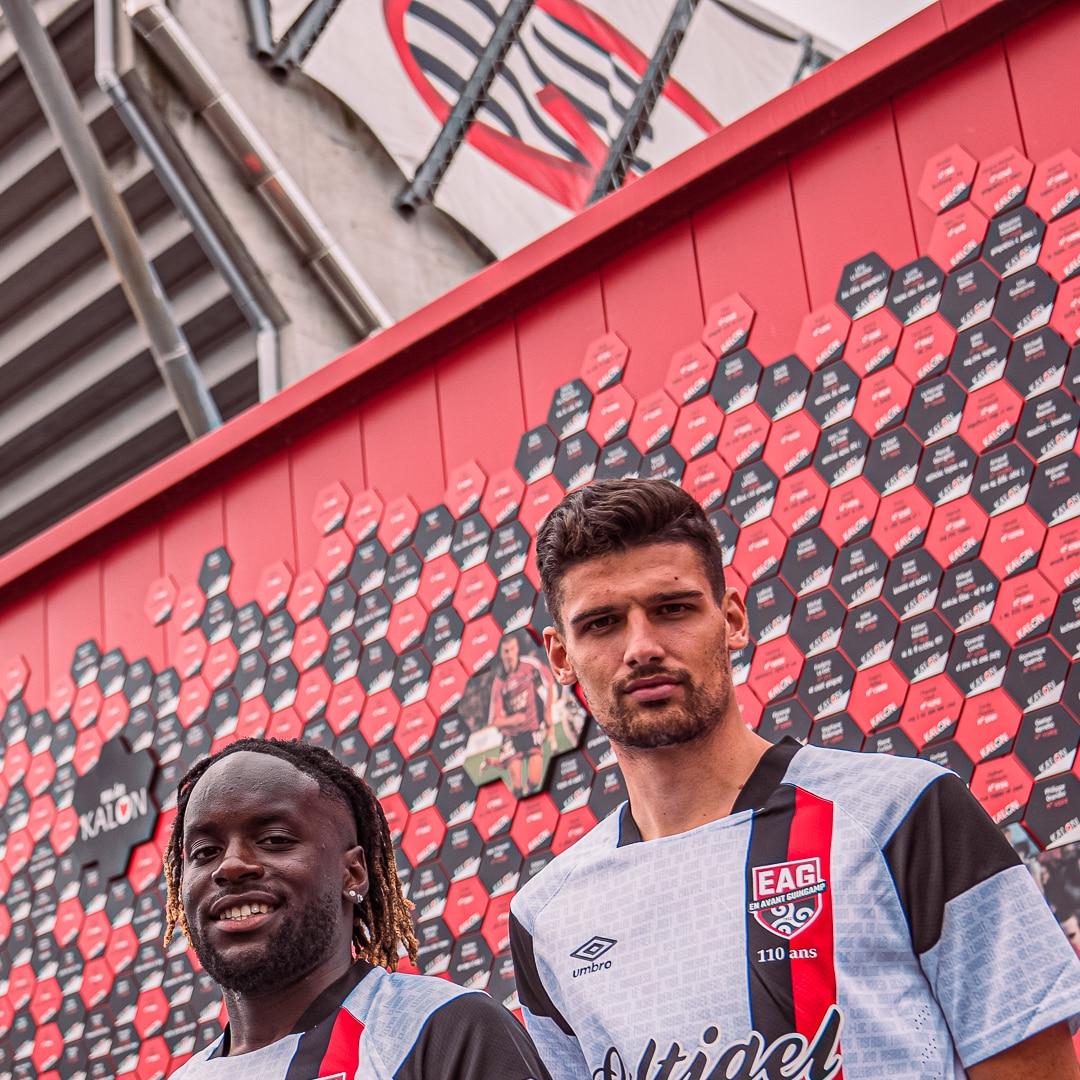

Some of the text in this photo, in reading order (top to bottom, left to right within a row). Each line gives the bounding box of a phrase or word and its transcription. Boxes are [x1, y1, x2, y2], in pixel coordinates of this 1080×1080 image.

[824, 397, 849, 422] KALON
[874, 405, 902, 431] KALON
[928, 412, 955, 438] KALON
[982, 421, 1010, 448] KALON
[1041, 429, 1069, 456] KALON
[833, 456, 857, 481] KALON
[884, 464, 910, 490] KALON
[938, 474, 965, 499] KALON
[994, 483, 1021, 509] KALON
[843, 517, 869, 541] KALON
[894, 527, 921, 552] KALON
[948, 537, 976, 563] KALON
[1005, 548, 1034, 574] KALON
[852, 577, 877, 602] KALON
[904, 588, 931, 614] KALON
[959, 600, 987, 625] KALON
[809, 626, 834, 650] KALON
[1016, 613, 1045, 640] KALON
[861, 638, 887, 663] KALON
[914, 650, 941, 676] KALON
[969, 664, 998, 691] KALON
[818, 689, 843, 713] KALON
[1027, 680, 1056, 705] KALON
[870, 702, 896, 727] KALON
[923, 717, 951, 742] KALON
[979, 733, 1008, 759] KALON
[1038, 748, 1068, 775] KALON
[79, 787, 147, 841] KALON
[758, 864, 816, 896] EAG
[749, 882, 826, 911] EN AVANT GUINGAMP
[757, 946, 817, 963] 110 ans
[572, 960, 612, 978] umbro
